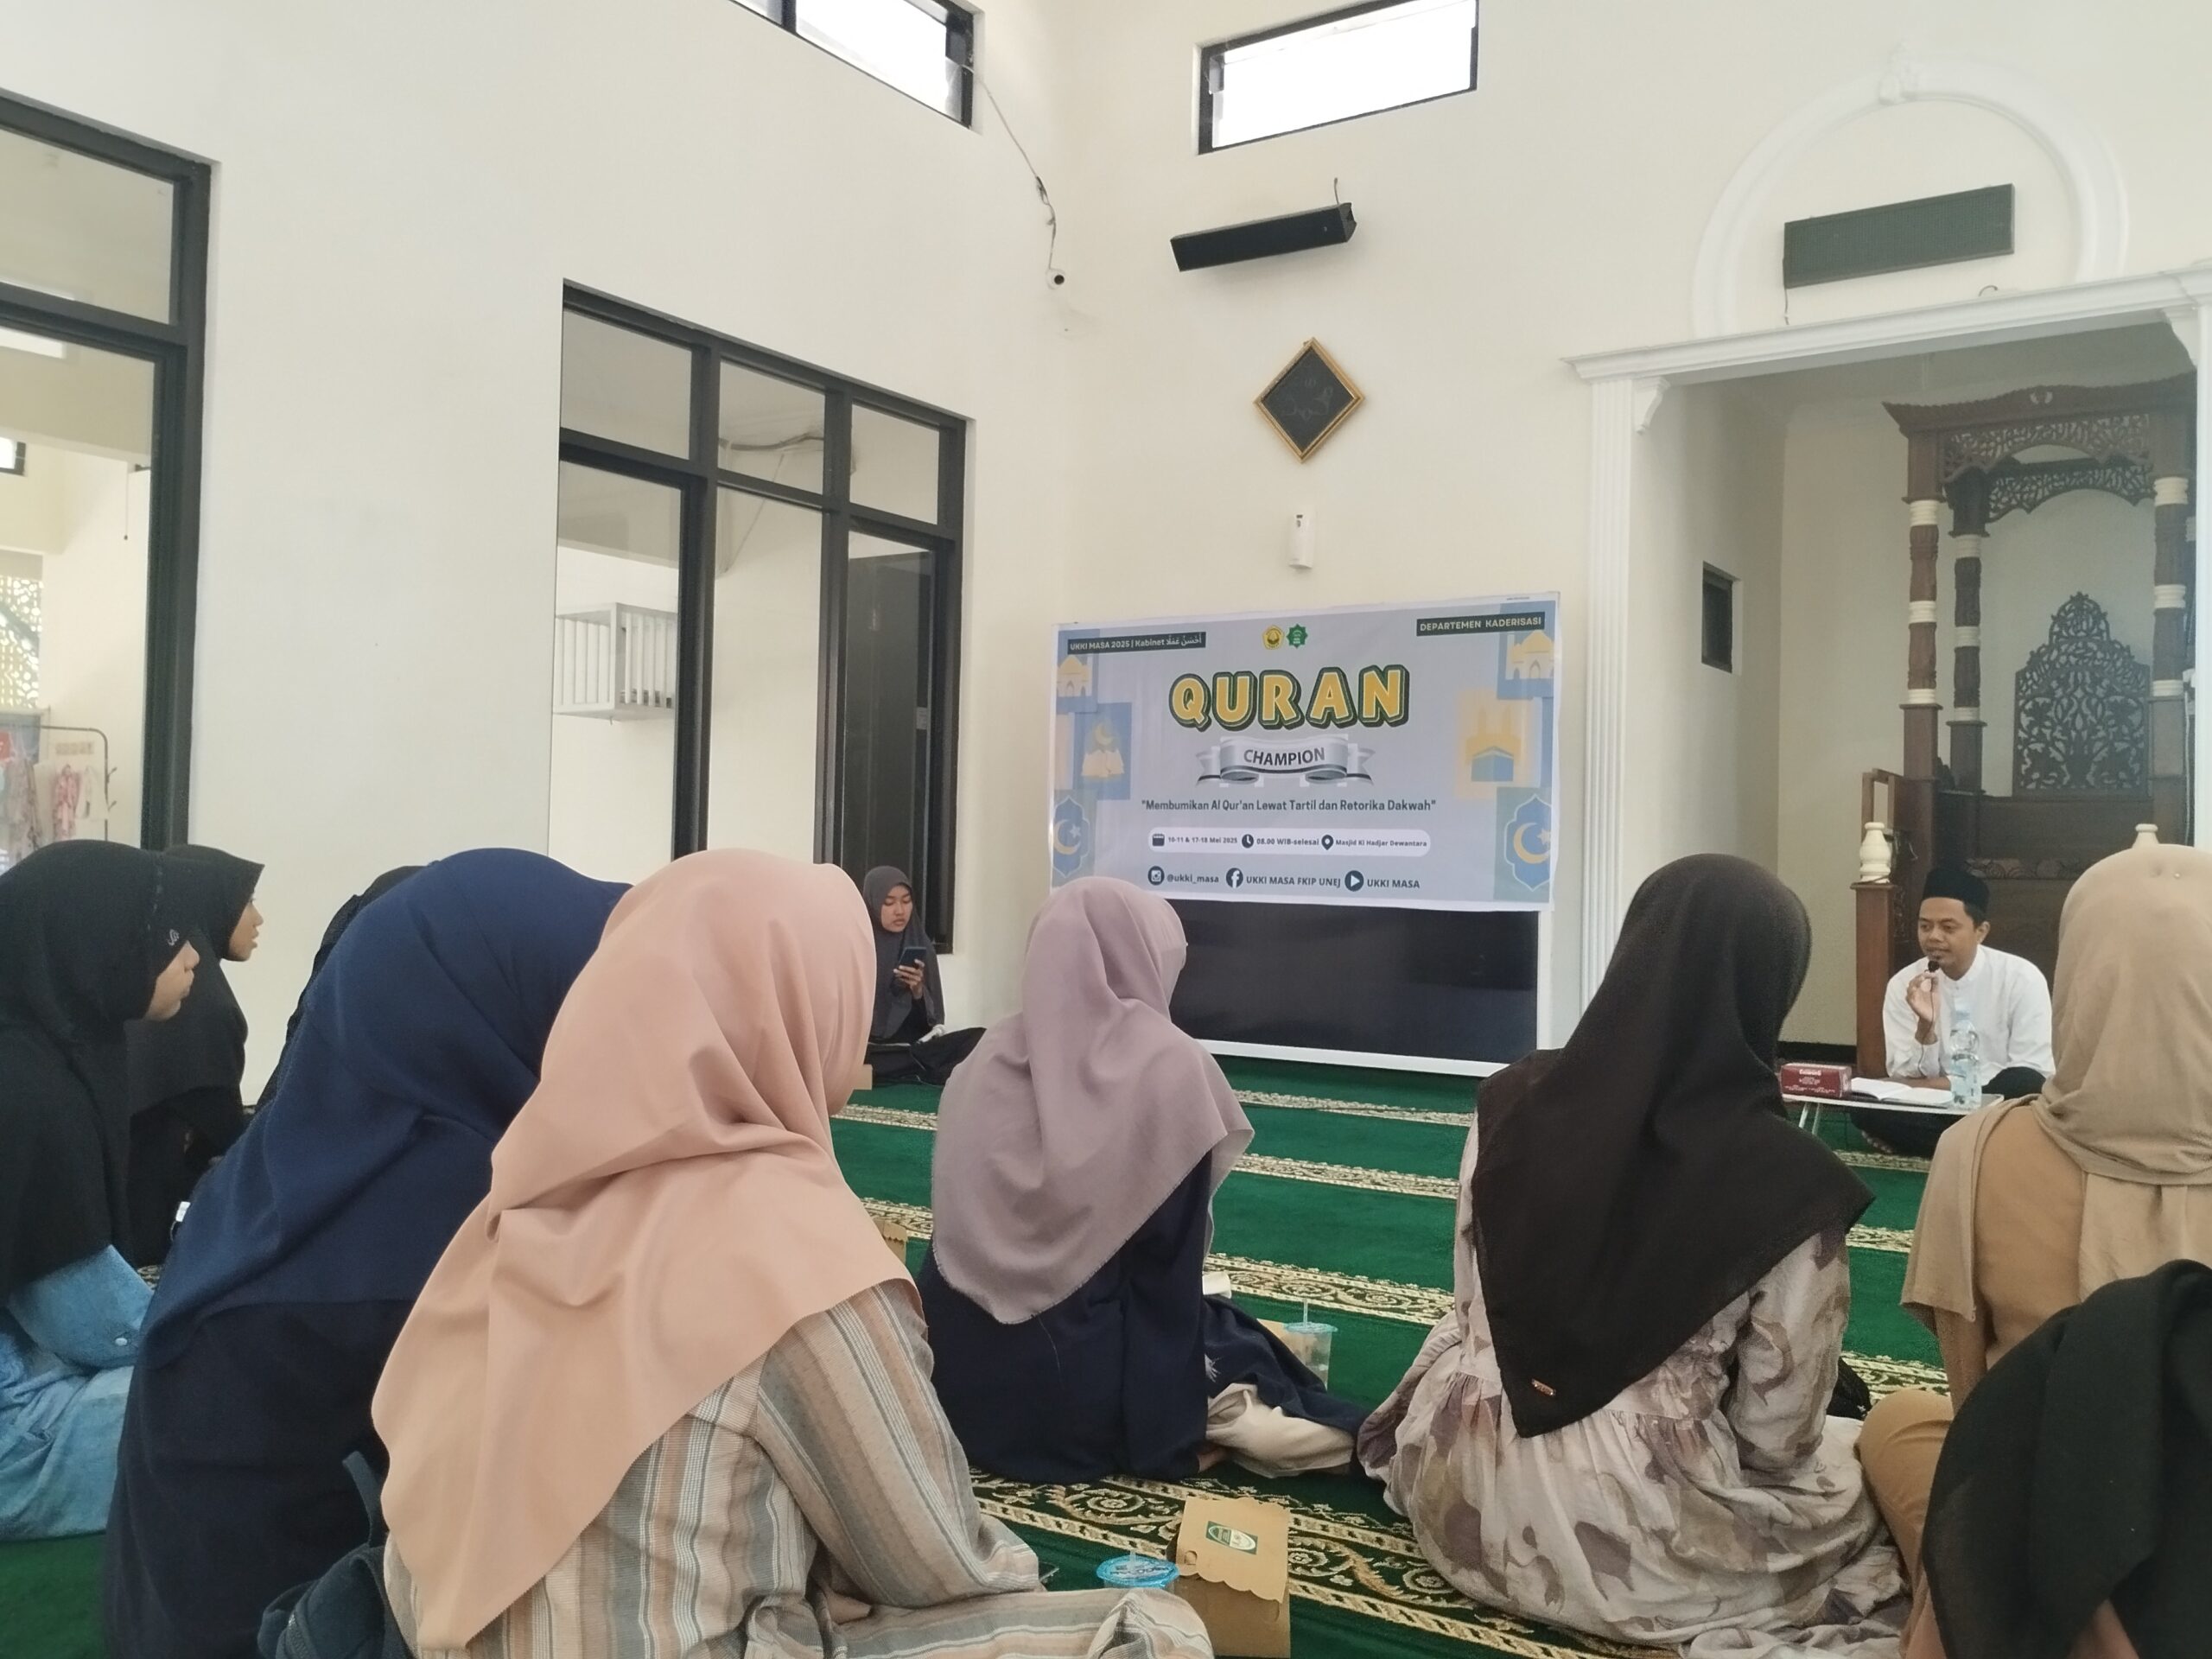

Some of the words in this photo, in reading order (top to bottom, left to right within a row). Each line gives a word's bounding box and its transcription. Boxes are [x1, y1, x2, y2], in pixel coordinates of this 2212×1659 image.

[1420, 620, 1482, 632] DEPARTEMEN
[1485, 617, 1541, 627] KADERISASI
[1168, 664, 1409, 732] QURAN
[1243, 747, 1325, 766] CHAMPION
[1141, 799, 1209, 810] "Membumikan
[1211, 799, 1220, 810] Al
[1222, 800, 1254, 810] Qur'an
[1256, 800, 1287, 810] Lewat
[1289, 799, 1317, 810] Tartil
[1319, 799, 1338, 810] dan
[1339, 799, 1385, 810] Retorika
[1388, 799, 1436, 810] Dakwah"
[1166, 874, 1219, 884] @ukki_masa
[1269, 876, 1295, 885] MASA
[1297, 877, 1316, 886] FKIP
[1319, 878, 1341, 888] UNEJ
[1367, 879, 1389, 887] UKKI
[1392, 880, 1421, 888] MASA
